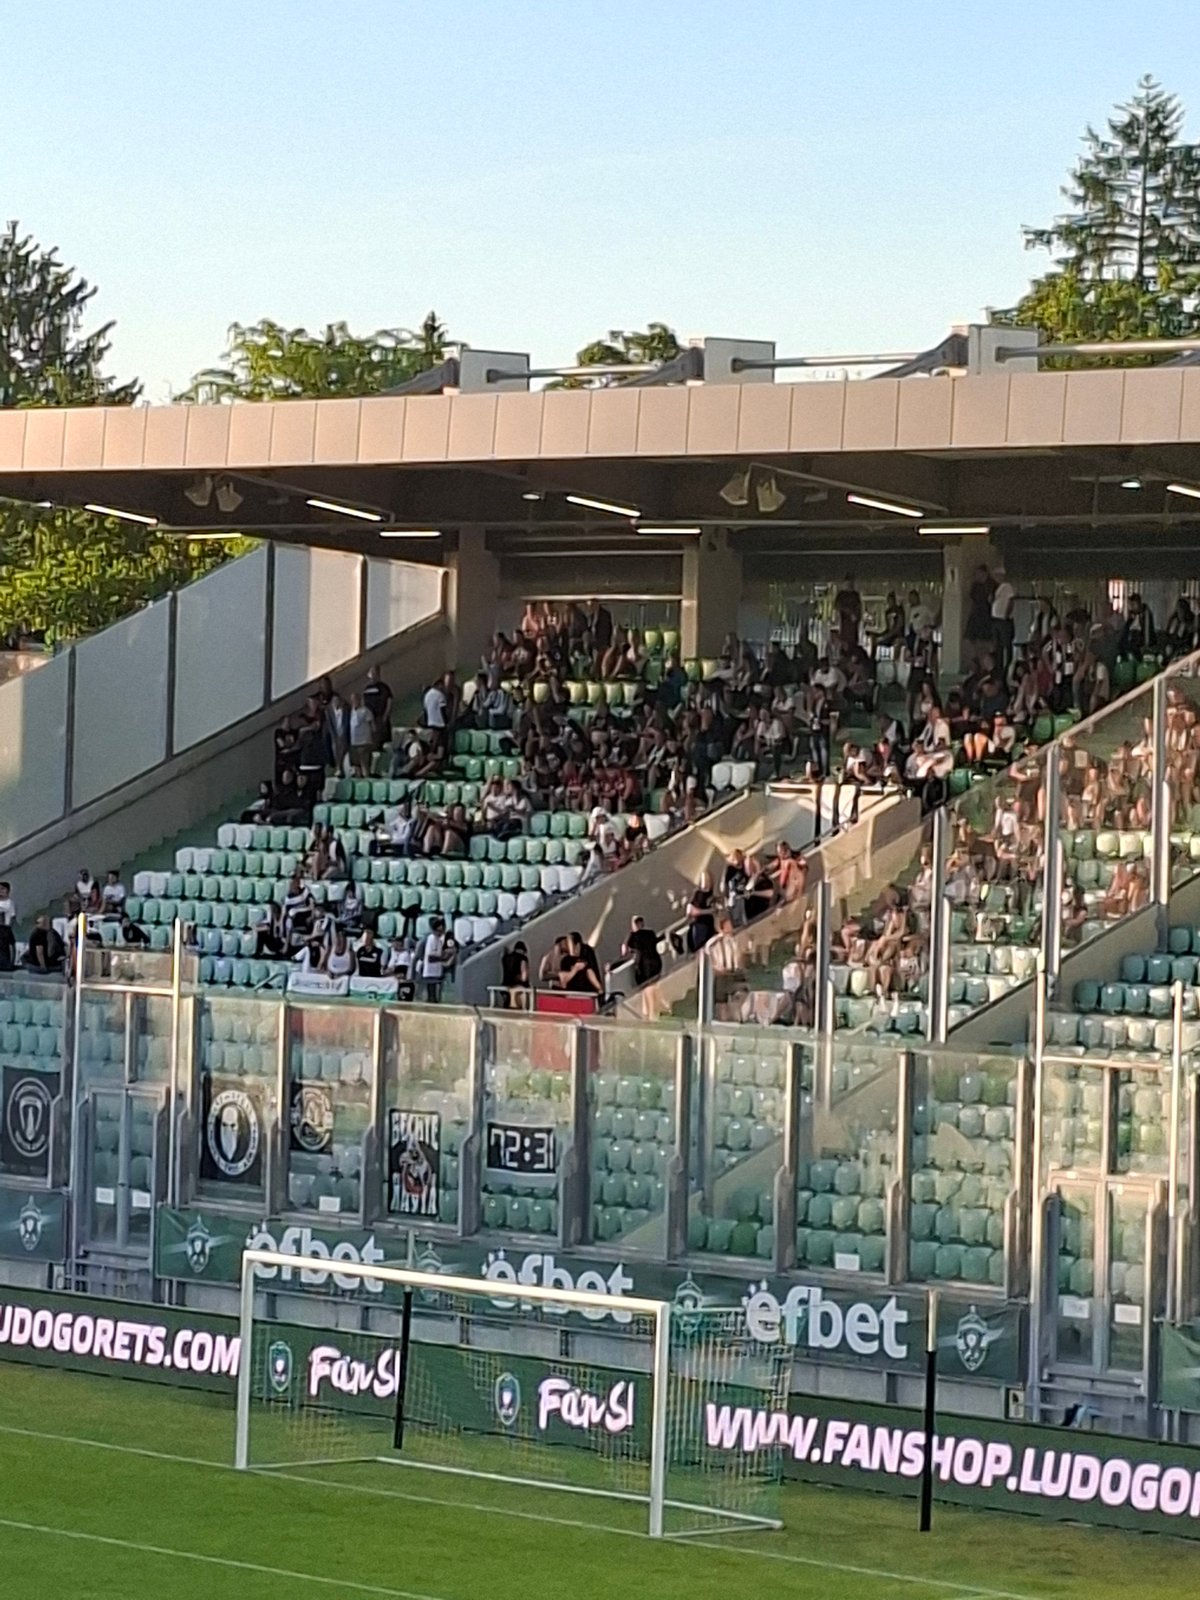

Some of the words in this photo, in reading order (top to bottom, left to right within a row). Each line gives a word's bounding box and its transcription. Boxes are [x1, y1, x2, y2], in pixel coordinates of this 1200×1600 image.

[246, 1222, 385, 1293] efbet
[482, 1249, 634, 1323] efbet
[742, 1279, 908, 1359] efbet
